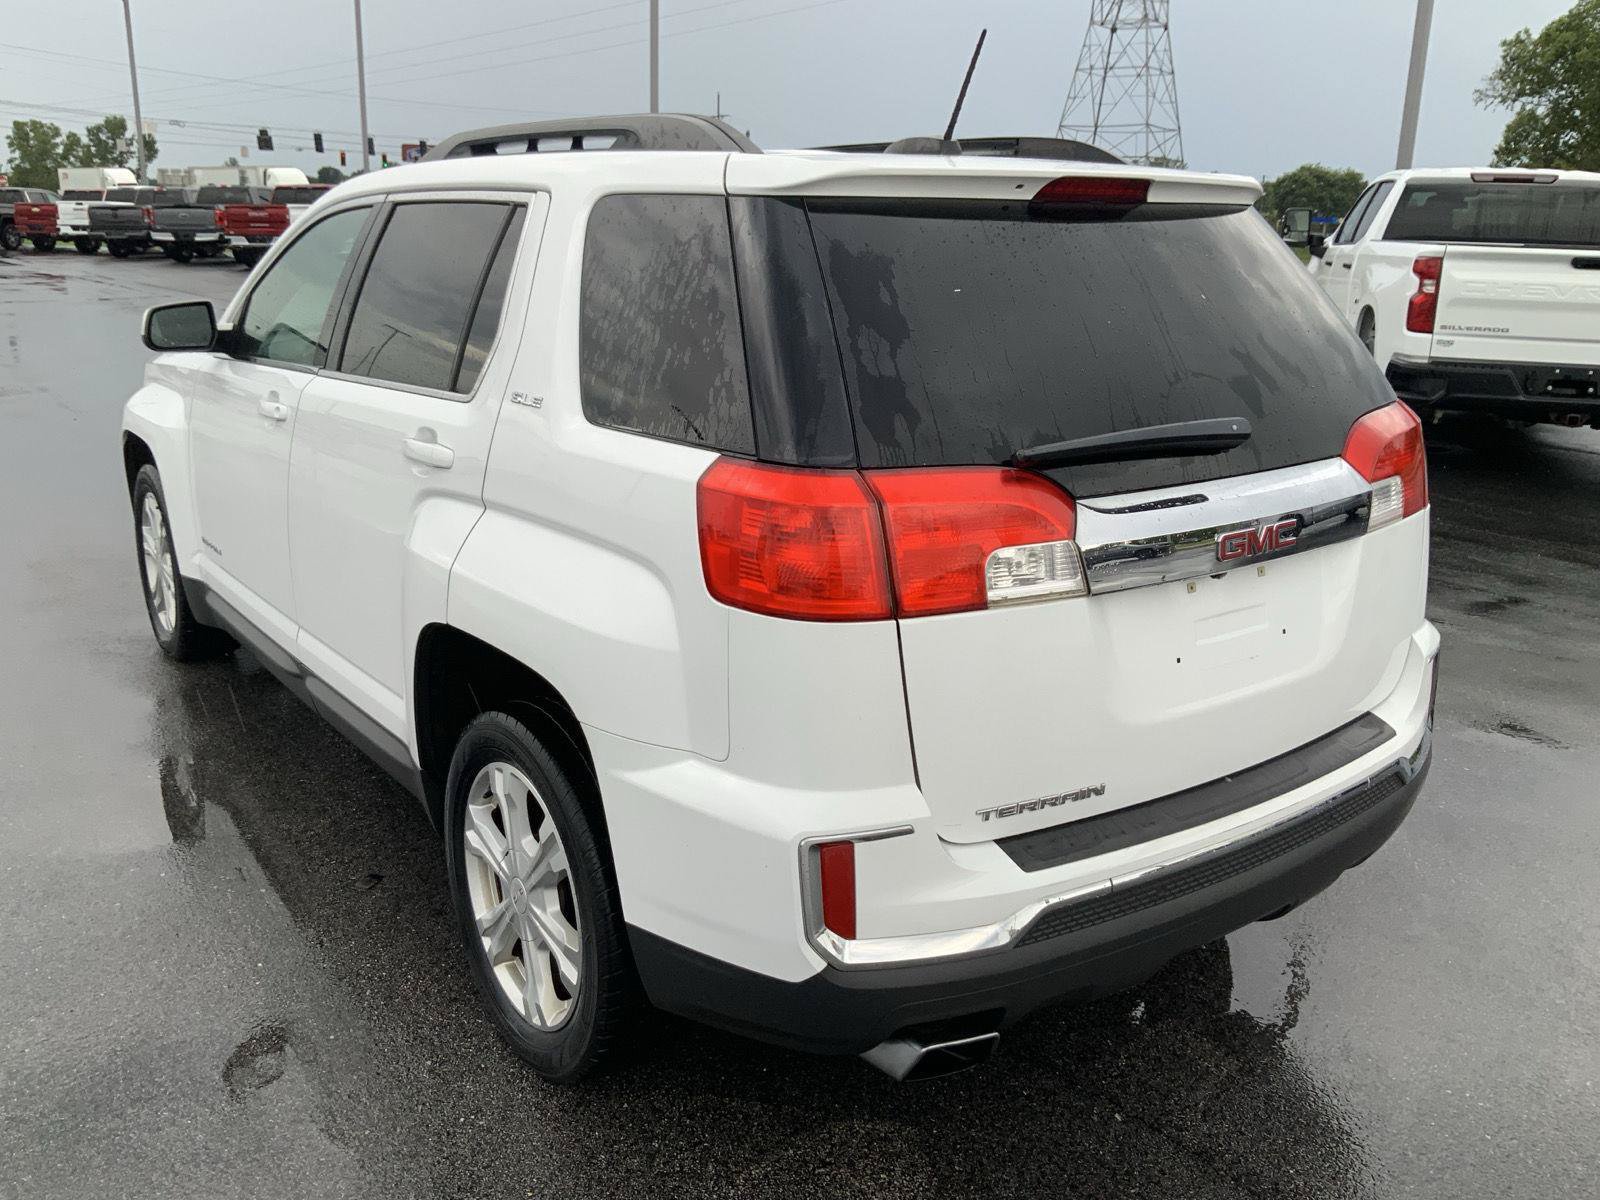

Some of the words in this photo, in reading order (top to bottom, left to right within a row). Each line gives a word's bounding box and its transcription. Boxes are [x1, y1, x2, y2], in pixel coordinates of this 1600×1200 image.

[1439, 324, 1510, 333] SILVERADO
[1216, 518, 1298, 562] GMC
[975, 783, 1106, 822] TERRAIN
